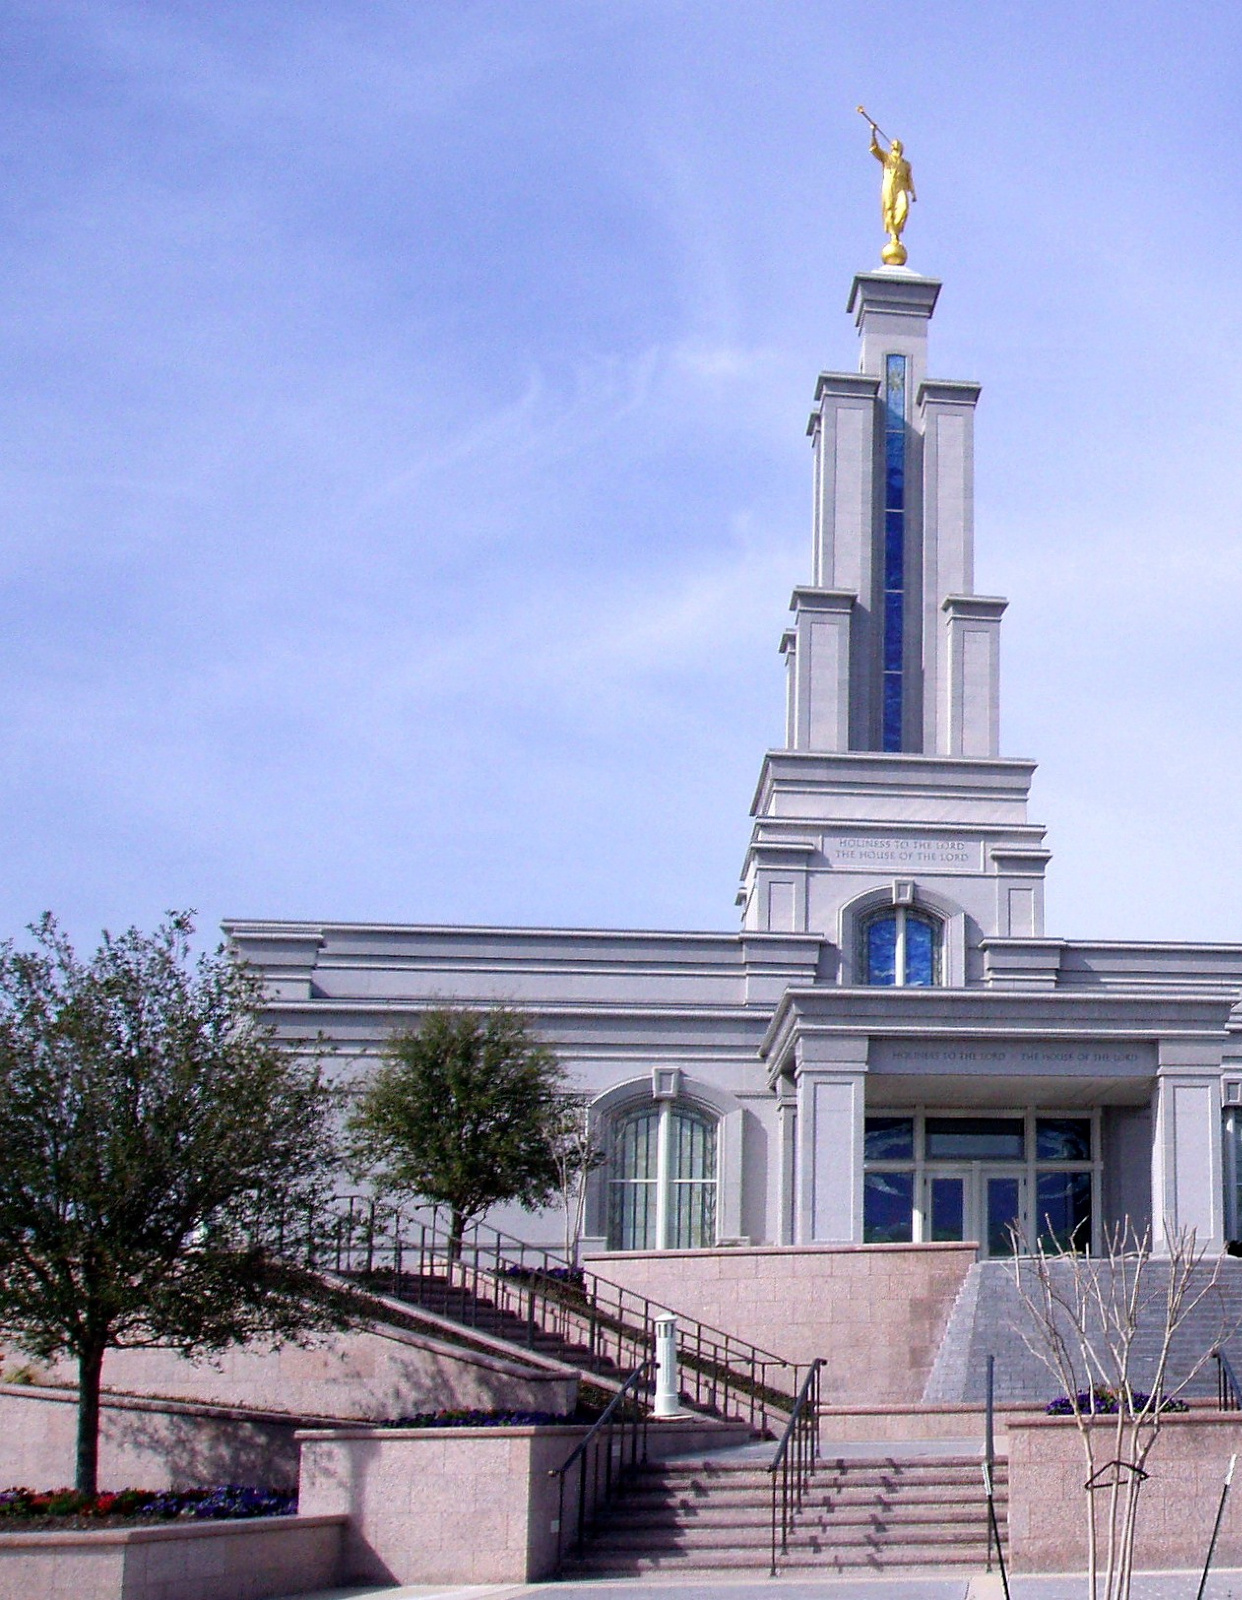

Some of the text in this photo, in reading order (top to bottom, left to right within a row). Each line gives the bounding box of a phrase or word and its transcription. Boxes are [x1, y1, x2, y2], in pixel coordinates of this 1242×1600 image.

[839, 839, 965, 851] HOLINESS TO THE LORD
[835, 850, 969, 862] THE HOUSE OF THE LORD
